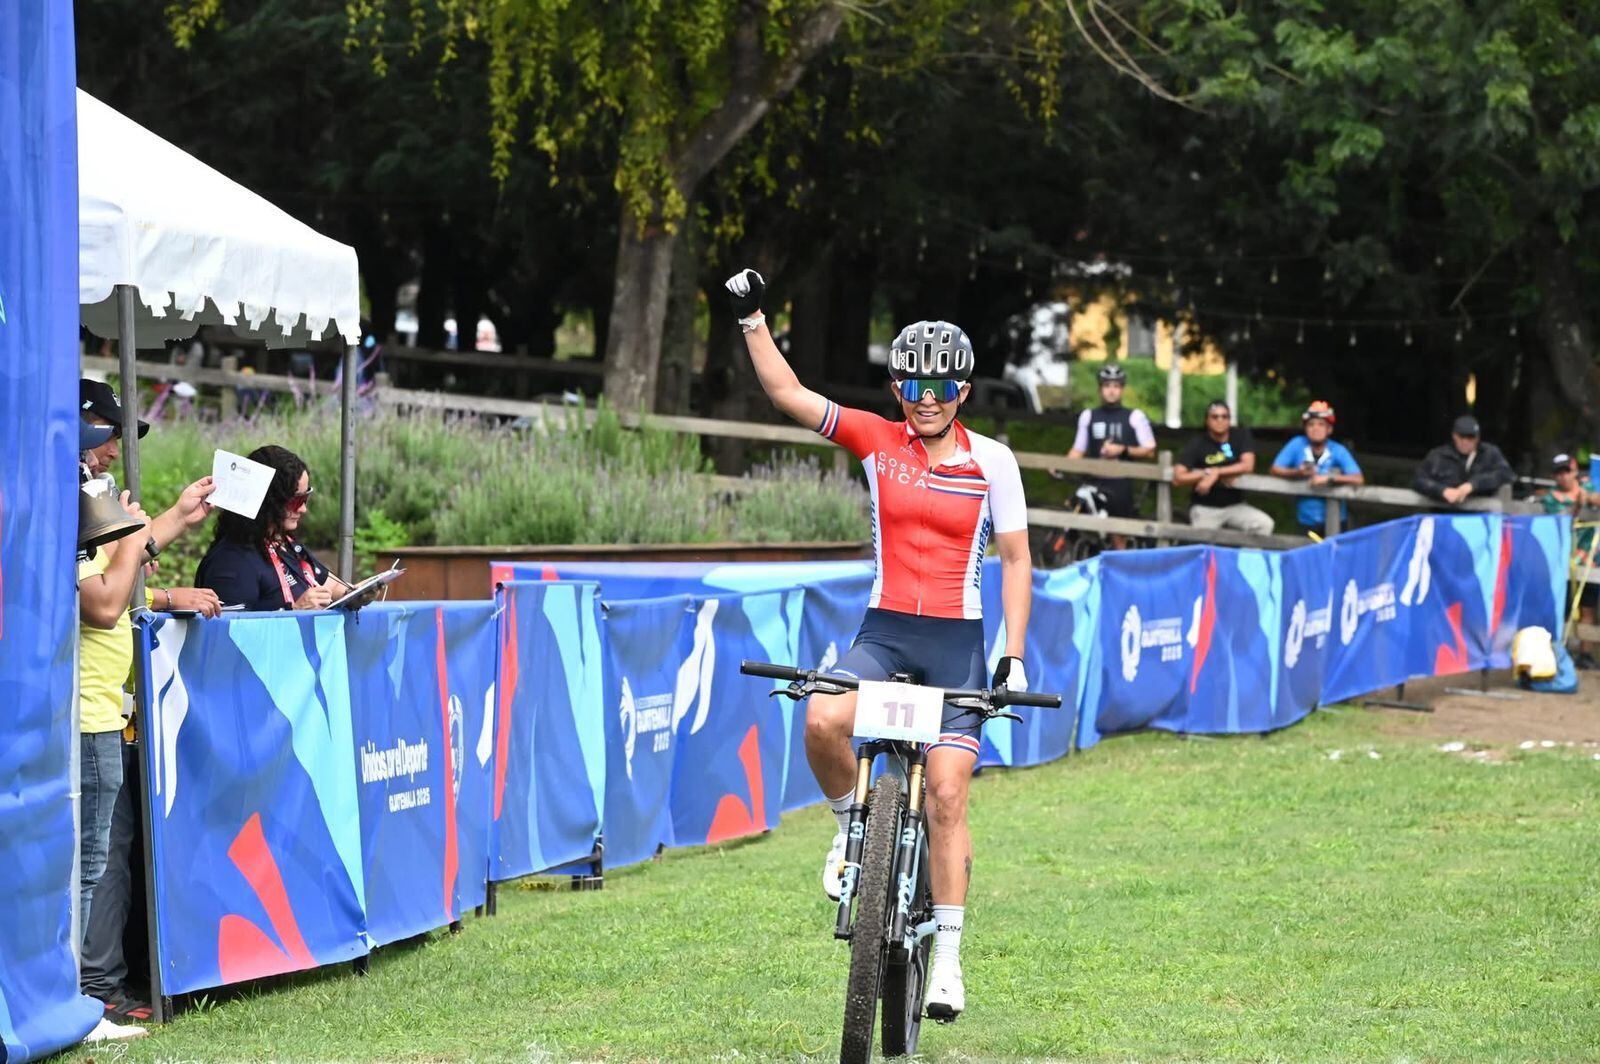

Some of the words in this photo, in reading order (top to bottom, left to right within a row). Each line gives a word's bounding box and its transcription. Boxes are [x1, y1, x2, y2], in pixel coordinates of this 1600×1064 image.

[877, 462, 927, 489] RICA
[878, 451, 928, 478] COSTA
[883, 701, 915, 729] 11
[850, 821, 864, 839] 3
